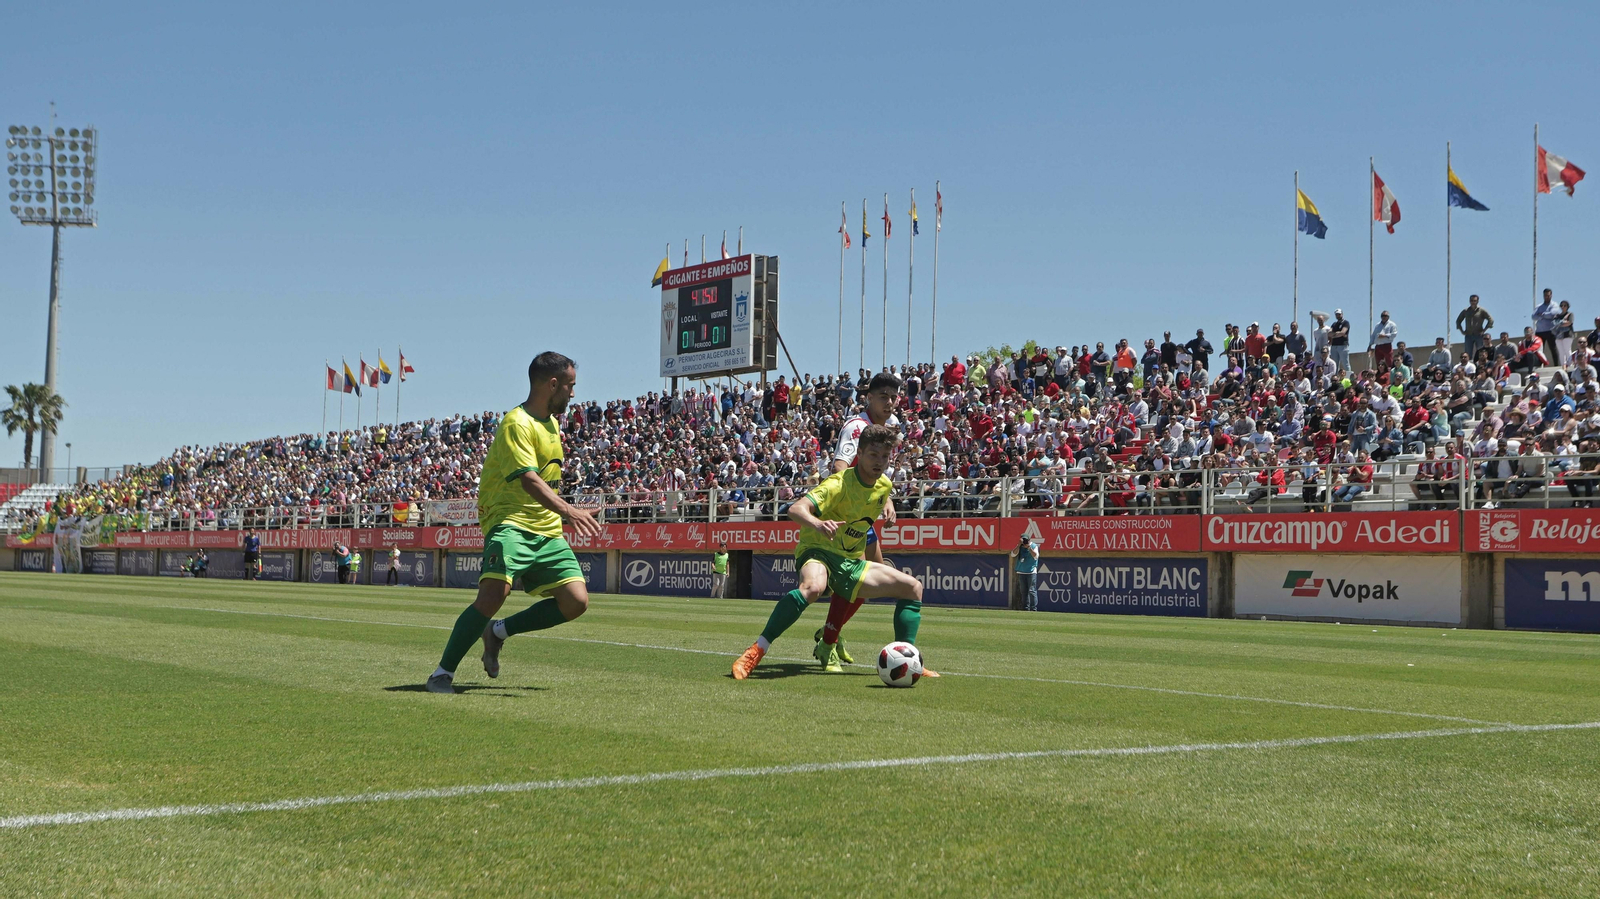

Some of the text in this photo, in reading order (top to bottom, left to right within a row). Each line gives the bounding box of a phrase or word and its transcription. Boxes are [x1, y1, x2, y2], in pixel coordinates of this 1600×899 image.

[669, 270, 700, 286] GIGANTE
[707, 260, 749, 279] EMPEÑOS
[681, 315, 698, 323] LOCAL
[710, 310, 728, 319] VISITANTE
[694, 341, 712, 349] PERIODO
[678, 353, 706, 364] PERMOTOR
[707, 349, 736, 360] ALGECIRAS
[682, 362, 702, 372] SERVICIO
[702, 360, 720, 370] OFICIAL
[1051, 518, 1172, 530] MATERIALES CONSTRUCCIÓN
[1354, 519, 1450, 544] Adedi
[1480, 512, 1491, 550] GALVEZ
[1529, 518, 1600, 545] Reloje
[144, 534, 187, 545] Mercure HOTEL
[300, 530, 319, 547] PURO
[321, 529, 351, 547] ESTRECHO
[382, 530, 415, 540] Socialistas
[454, 528, 485, 537] HYUNDA
[711, 529, 801, 544] HOTELES ALBO
[454, 538, 485, 547] PERMOTOR
[1053, 533, 1172, 549] AGUA MARINA
[22, 551, 45, 570] NACEX
[659, 560, 712, 575] HYUNDAI
[771, 559, 797, 572] ALAIN
[208, 567, 246, 578] Manhattan
[1077, 567, 1201, 591] MONT BLANC
[659, 576, 712, 590] PERMOTOR
[1077, 589, 1200, 608] lavandería industrial
[1326, 579, 1399, 603] Vopak
